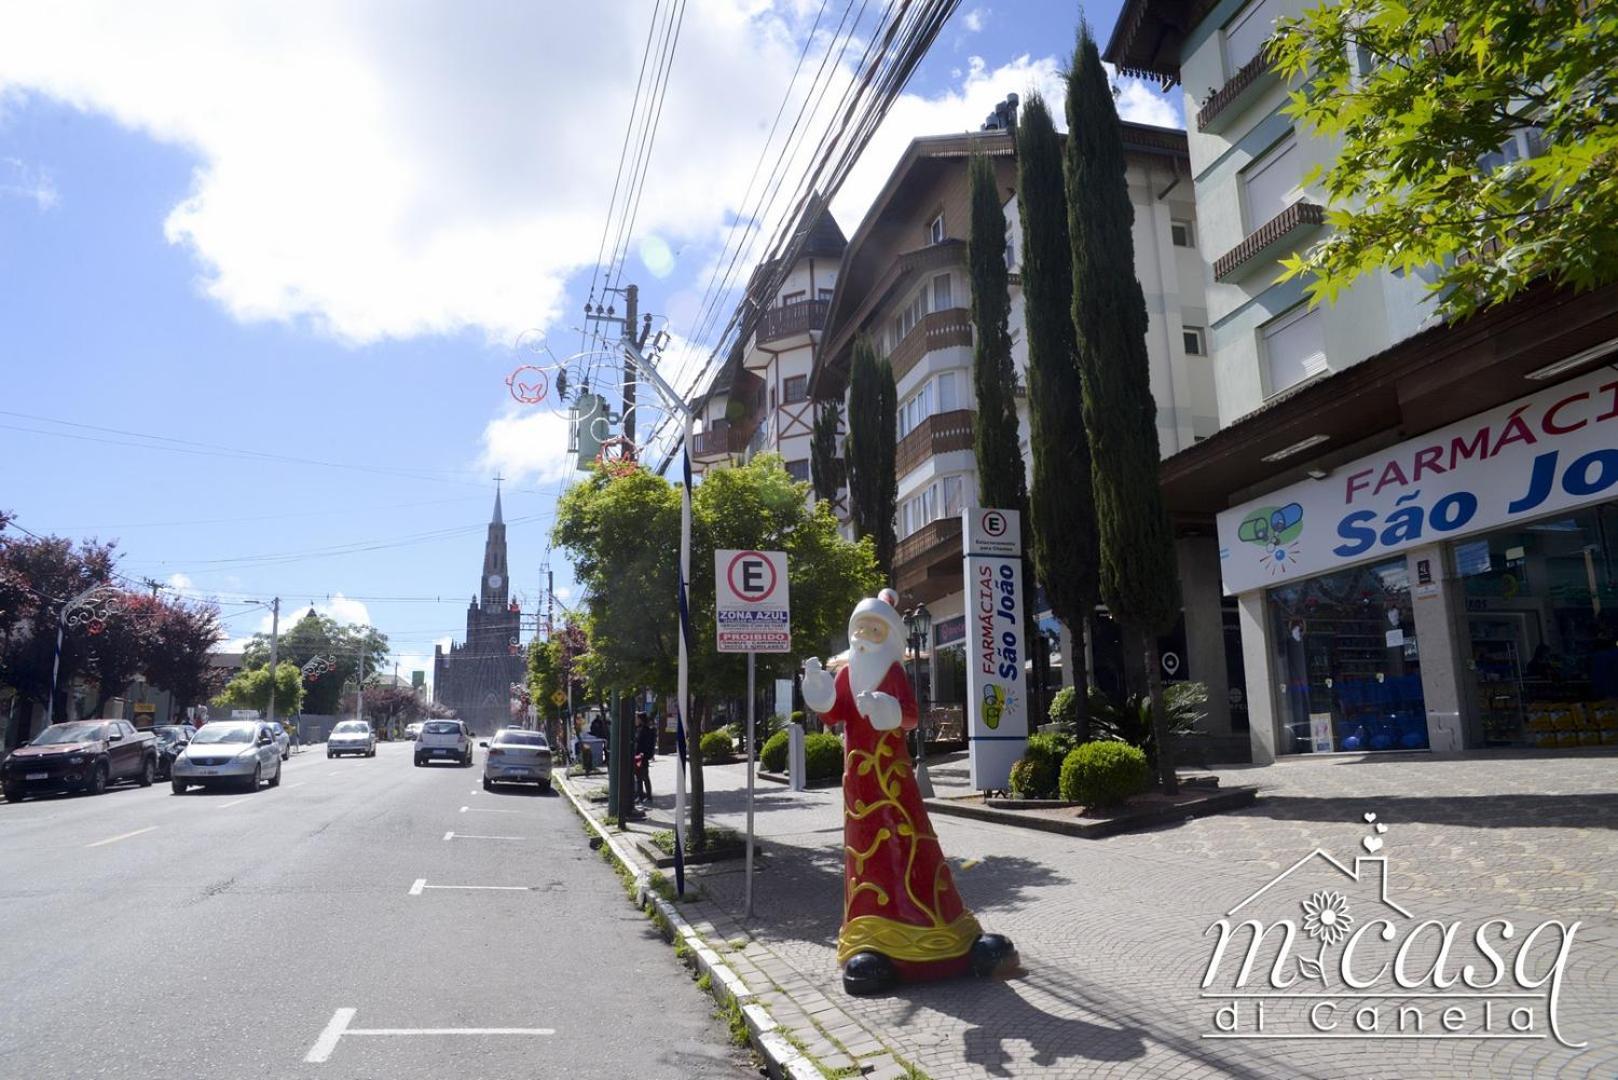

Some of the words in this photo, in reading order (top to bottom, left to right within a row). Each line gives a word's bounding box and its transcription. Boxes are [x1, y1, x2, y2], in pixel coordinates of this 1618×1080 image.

[988, 517, 1000, 531] E
[1333, 489, 1478, 557] São
[743, 560, 764, 592] E
[995, 564, 1016, 625] João
[720, 611, 753, 619] ZONA
[756, 611, 786, 620] AZUL
[979, 565, 996, 675] FARMÁCIAS
[723, 633, 785, 641] PROIBIDO
[997, 631, 1018, 681] São
